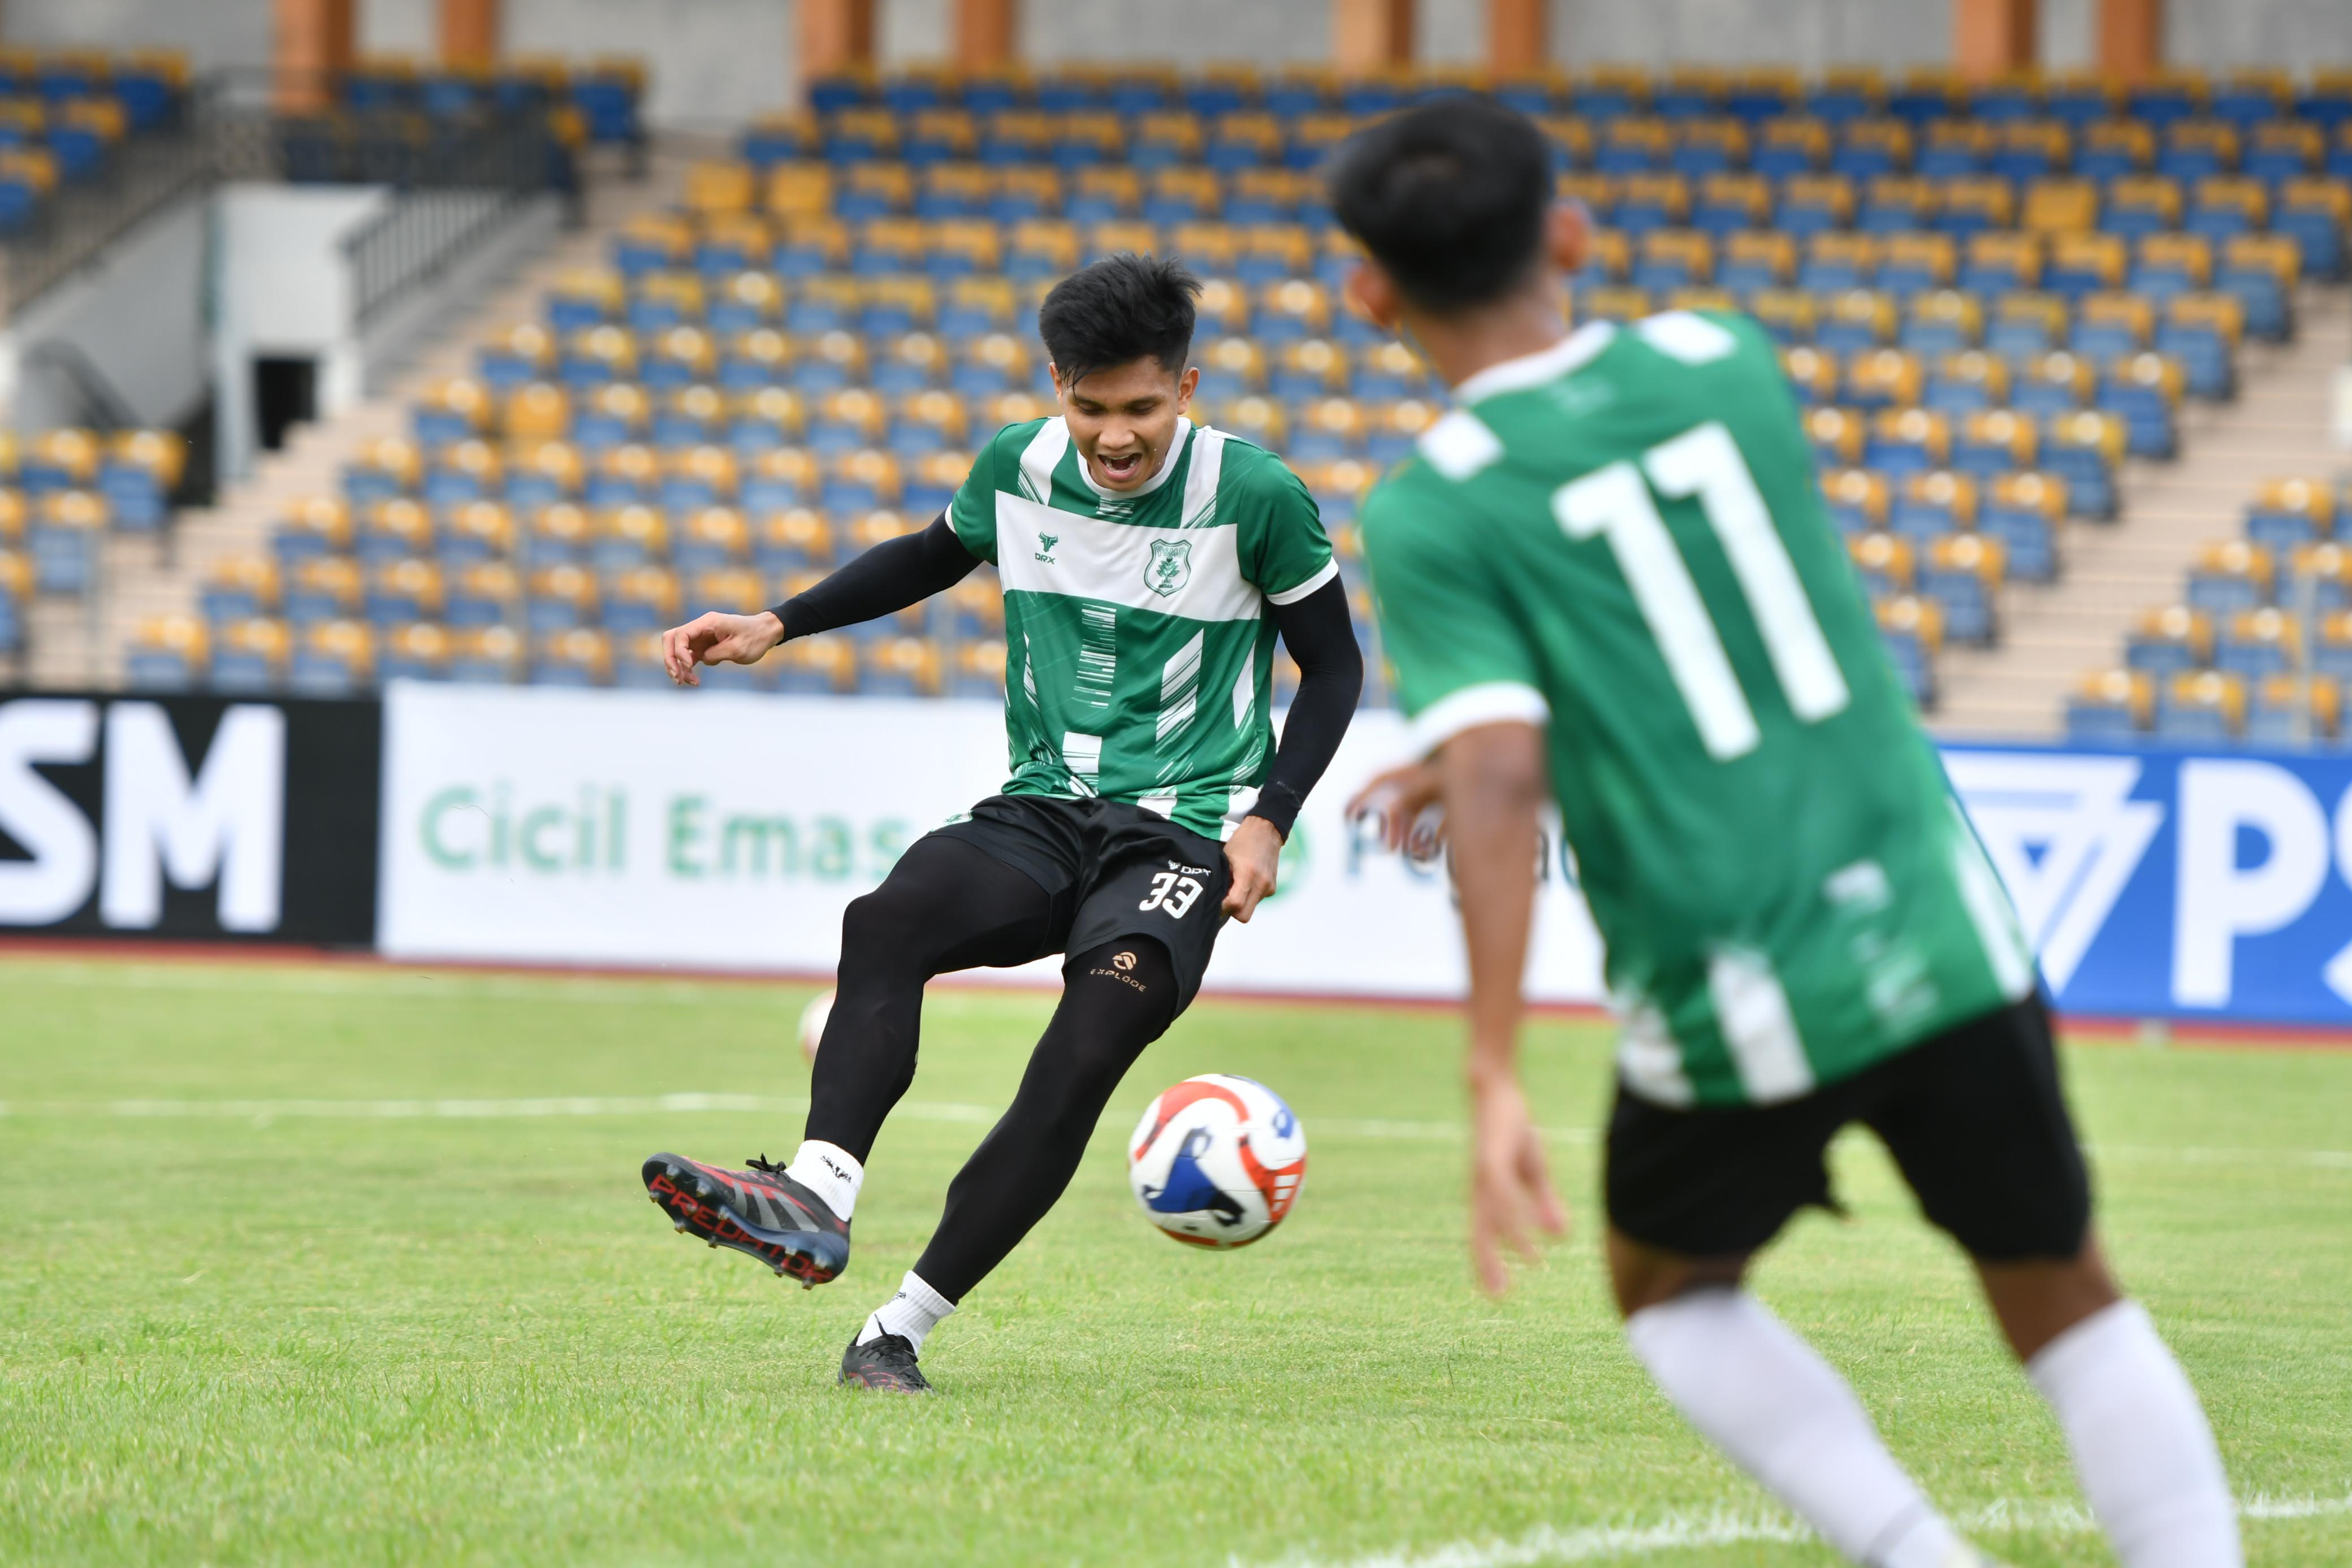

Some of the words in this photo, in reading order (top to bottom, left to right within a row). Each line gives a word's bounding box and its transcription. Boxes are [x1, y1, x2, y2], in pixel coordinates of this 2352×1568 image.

[1156, 545, 1186, 558] PSMS
[1550, 420, 1850, 764] 11
[0, 699, 287, 932] SM
[418, 781, 629, 875] Cicil
[665, 792, 920, 885] Emas
[1139, 872, 1204, 919] 33
[2170, 756, 2352, 1010] P
[1089, 968, 1147, 992] EXPLODE
